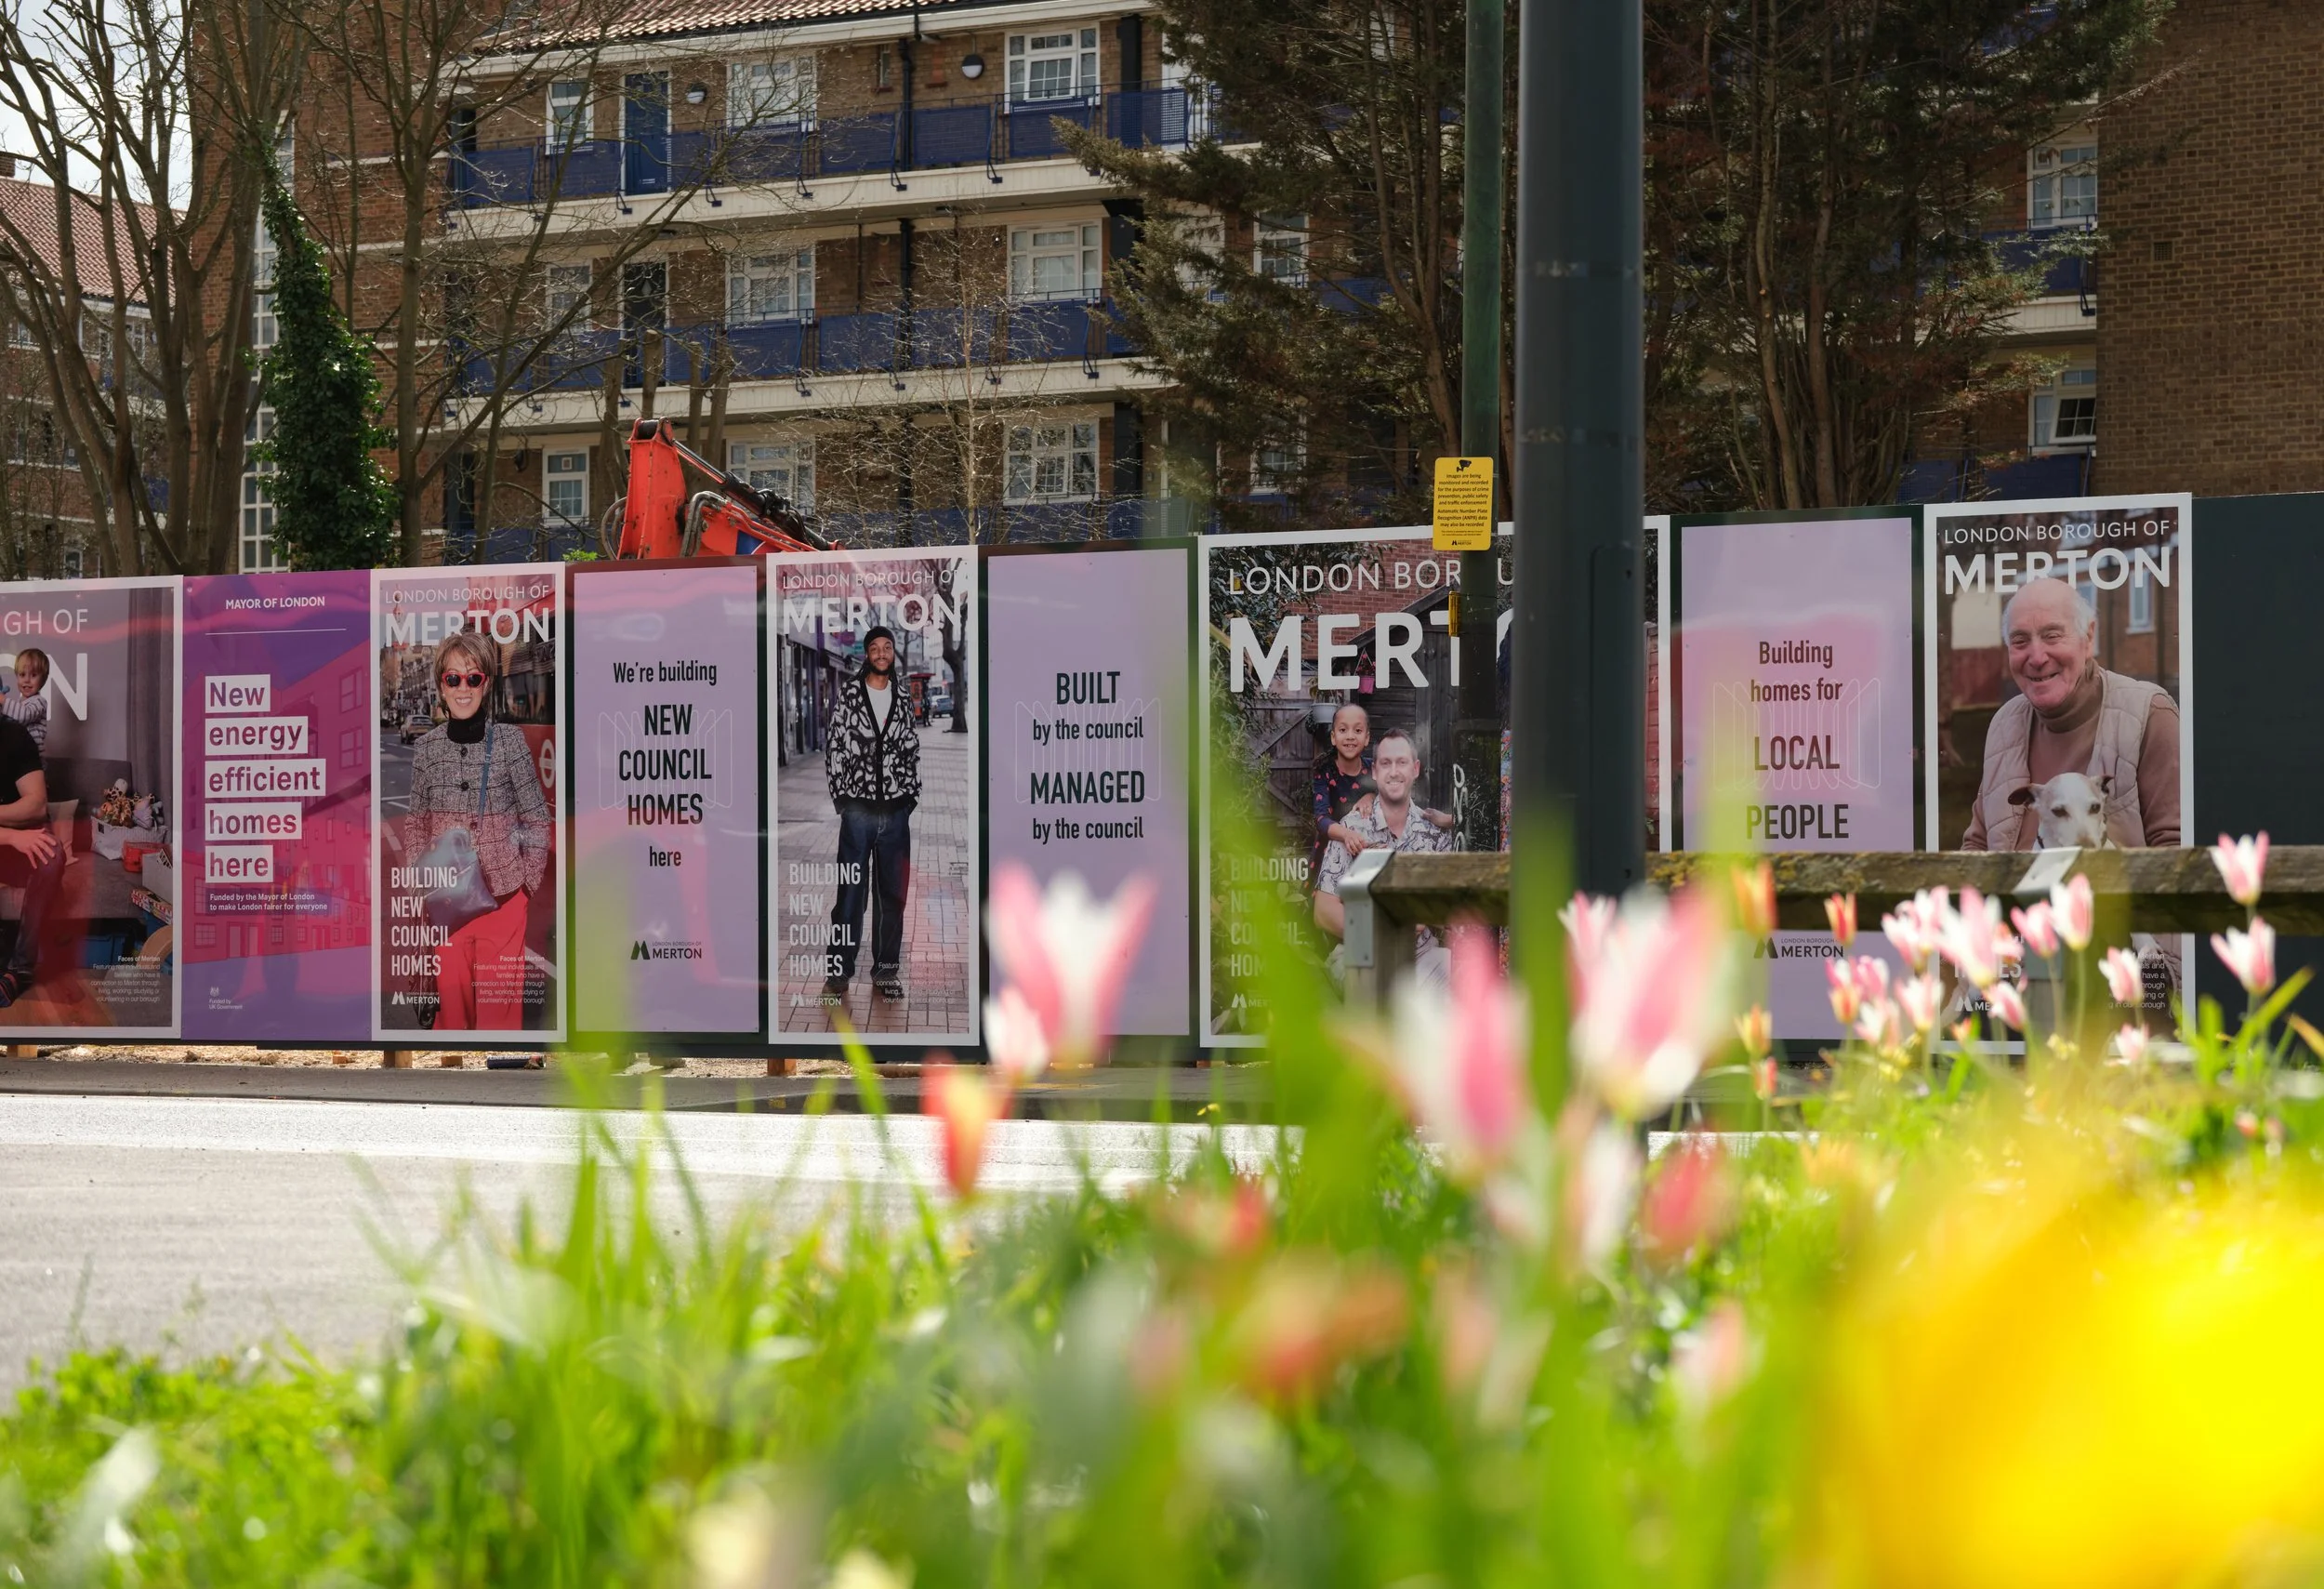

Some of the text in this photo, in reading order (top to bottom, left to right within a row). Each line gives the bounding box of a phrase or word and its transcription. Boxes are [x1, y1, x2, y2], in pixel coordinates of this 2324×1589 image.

[1945, 520, 2170, 544] LONDON BOROUGH OF
[783, 574, 850, 589] LONDON
[855, 571, 934, 587] BOROUGH
[1229, 562, 1380, 595] LONDON
[1945, 546, 2170, 595] MERTON
[225, 596, 325, 610] MAYOR OF LONDON
[386, 585, 549, 604] LONDON BOROUGH OF
[53, 608, 88, 634] OF
[784, 593, 971, 634] MERTON
[386, 607, 549, 647] MERTON
[1230, 609, 1513, 693] MERT
[1759, 640, 1833, 669] Building
[613, 660, 717, 686] We're building
[209, 682, 265, 708] New
[1056, 671, 1120, 705] BUILT
[1750, 677, 1843, 702] homes for
[644, 704, 693, 735] NEW
[1033, 716, 1143, 746] by the council
[209, 725, 302, 751] energy
[619, 748, 712, 781] COUNCIL
[1754, 735, 1841, 771] LOCAL
[208, 766, 321, 792] efficient
[1030, 771, 1145, 804] MANAGED
[209, 810, 297, 835] homes
[627, 793, 703, 826] HOMES
[1746, 803, 1849, 840] PEOPLE
[1033, 816, 1143, 845] by the council
[209, 852, 269, 878] here
[649, 846, 681, 867] here
[391, 867, 457, 889] BUILDING
[789, 863, 861, 885] BUILDING
[236, 894, 244, 902] by
[258, 894, 279, 902] Mayor
[391, 896, 424, 918] NEW
[789, 894, 824, 916] NEW
[391, 925, 454, 947] COUNCIL
[789, 924, 856, 947] COUNCIL
[391, 954, 442, 976] HOMES
[653, 948, 702, 959] MERTON
[1781, 946, 1843, 958] MERTON
[789, 955, 843, 977] HOMES
[406, 996, 440, 1004] MERTON
[805, 997, 841, 1006] MERTON
